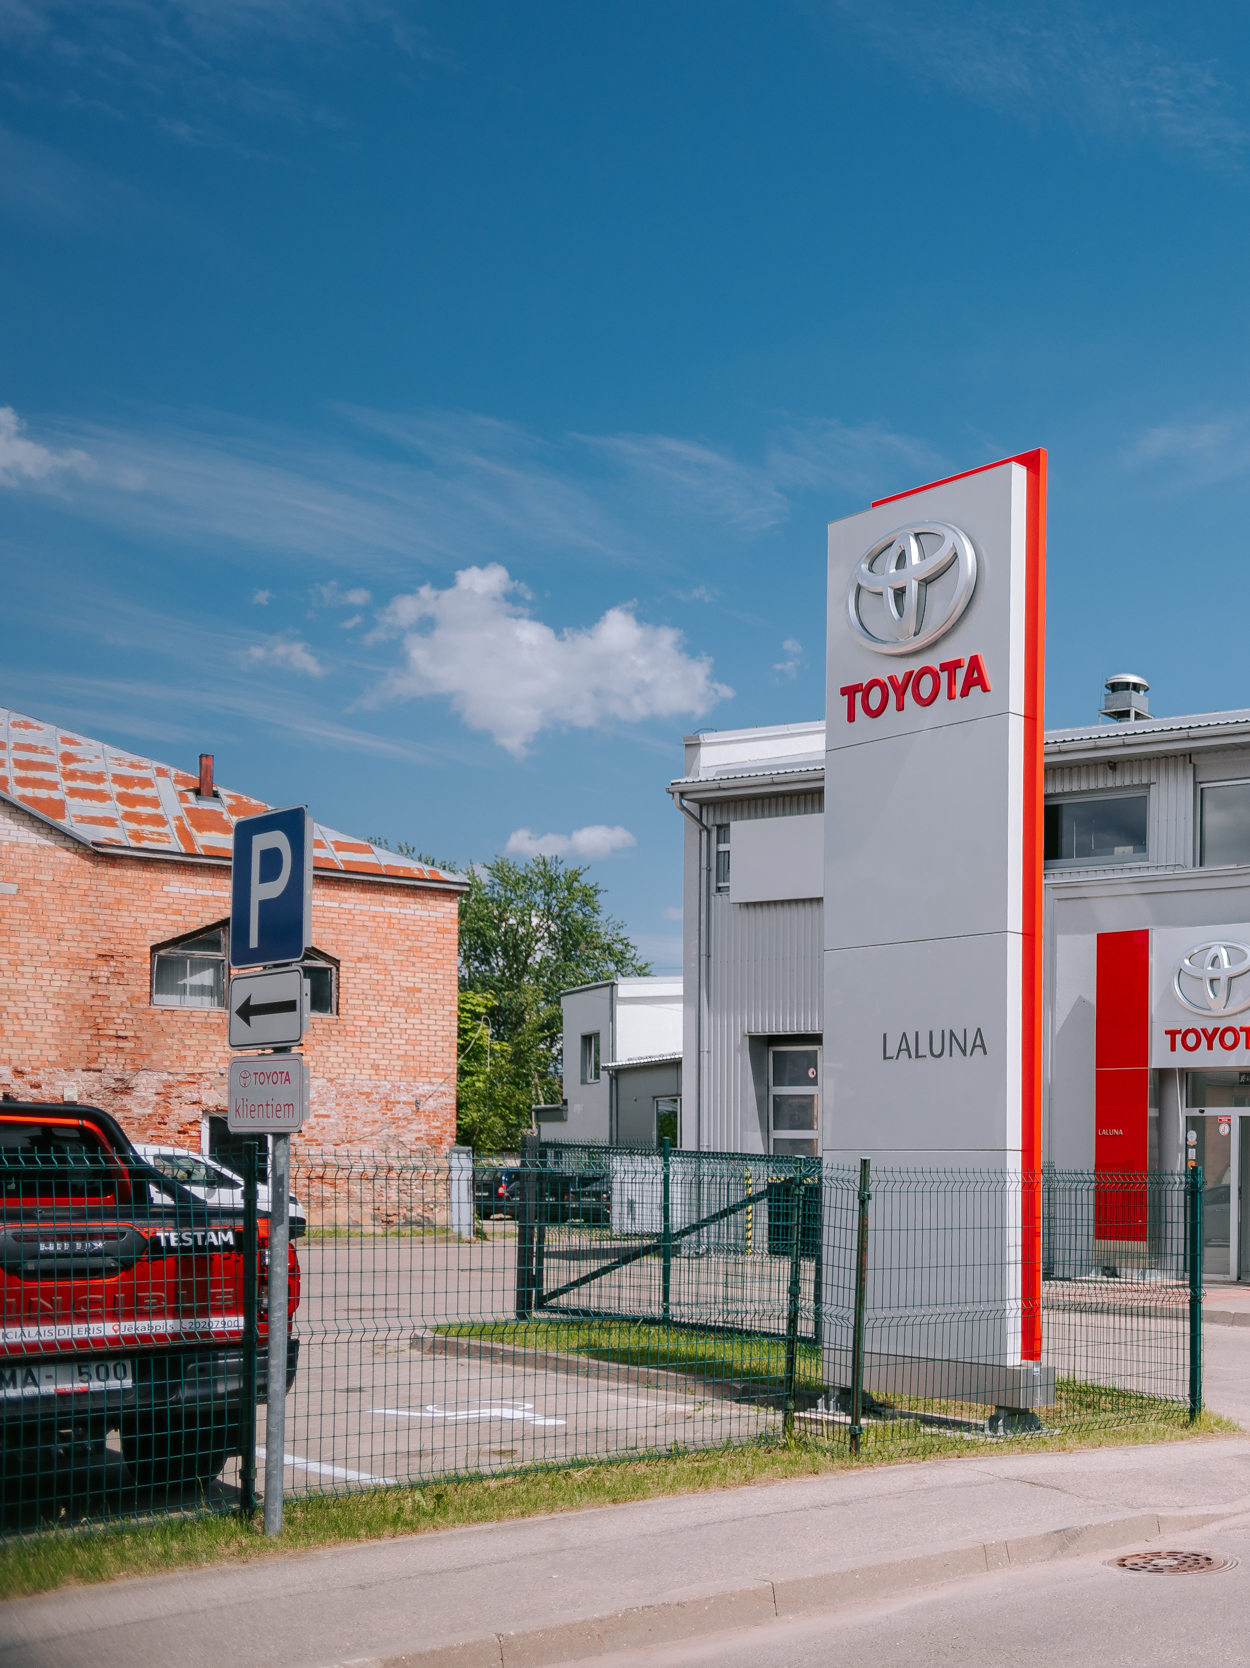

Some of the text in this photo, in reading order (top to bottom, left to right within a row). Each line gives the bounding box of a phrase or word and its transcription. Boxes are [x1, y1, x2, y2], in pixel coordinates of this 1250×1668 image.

[839, 653, 992, 723] TOYOTA
[249, 829, 292, 949] P
[882, 1026, 989, 1062] LALUNA
[252, 1070, 292, 1086] TOYOTA
[234, 1097, 295, 1119] klientiem
[1098, 1128, 1123, 1136] LALUNA
